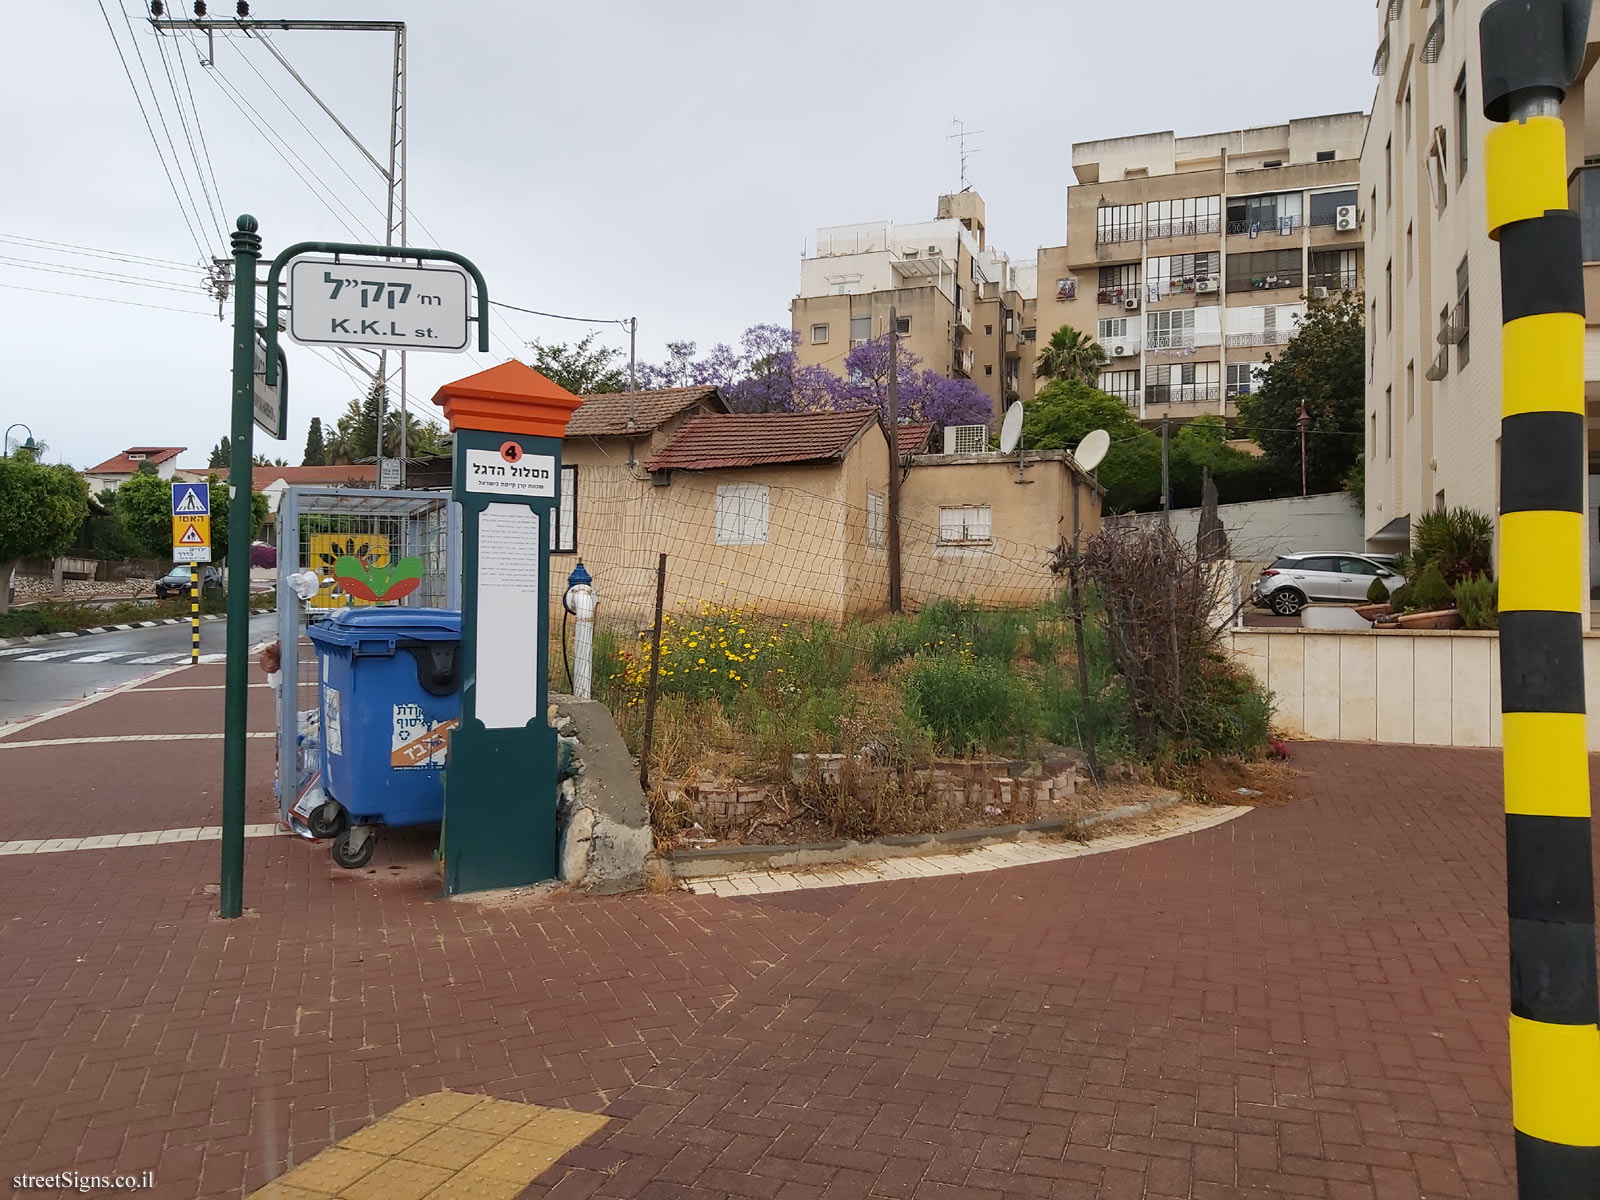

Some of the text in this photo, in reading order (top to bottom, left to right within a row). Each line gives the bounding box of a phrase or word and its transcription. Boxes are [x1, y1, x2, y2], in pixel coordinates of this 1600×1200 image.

[331, 318, 438, 338] K.K.L st.
[505, 446, 517, 459] 4
[473, 463, 549, 479] מסלול הדגל
